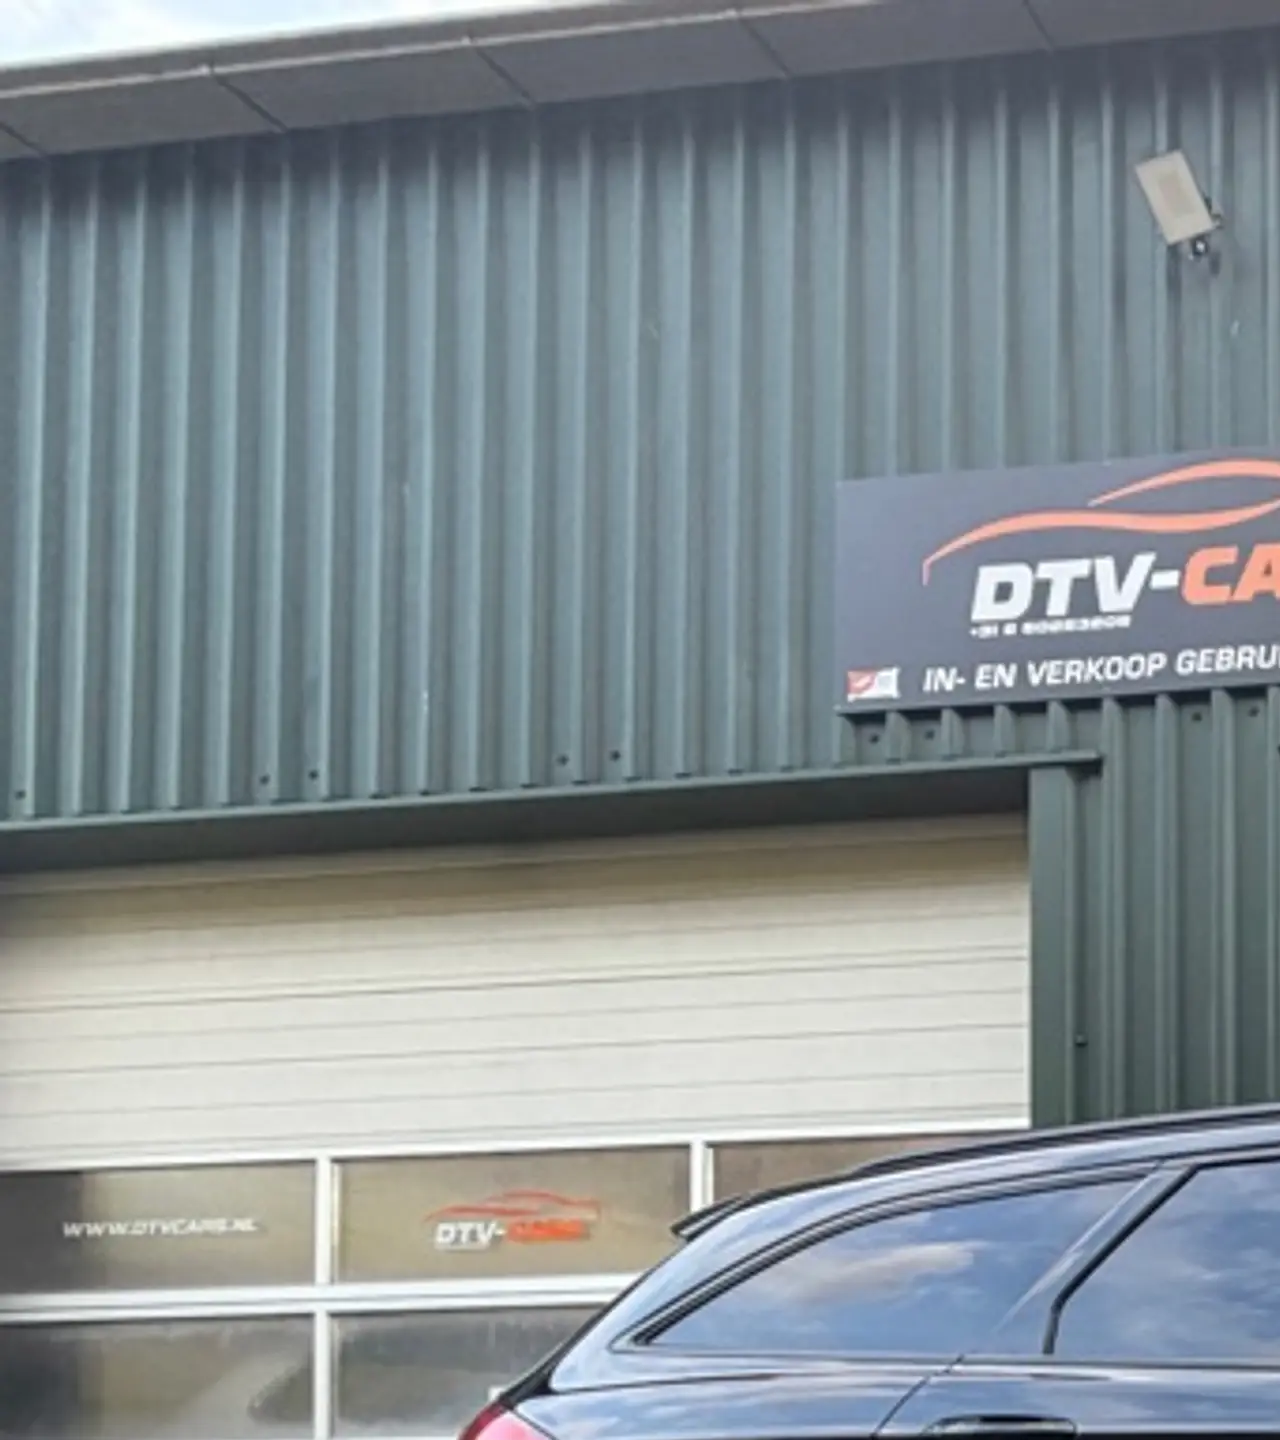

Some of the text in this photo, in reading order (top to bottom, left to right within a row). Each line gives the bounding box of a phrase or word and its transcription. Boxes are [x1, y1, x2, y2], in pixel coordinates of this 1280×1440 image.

[922, 665, 966, 693] IN-
[974, 662, 1018, 690] EN
[1027, 651, 1168, 687] VERKOOP
[435, 1218, 592, 1245] DTV-
